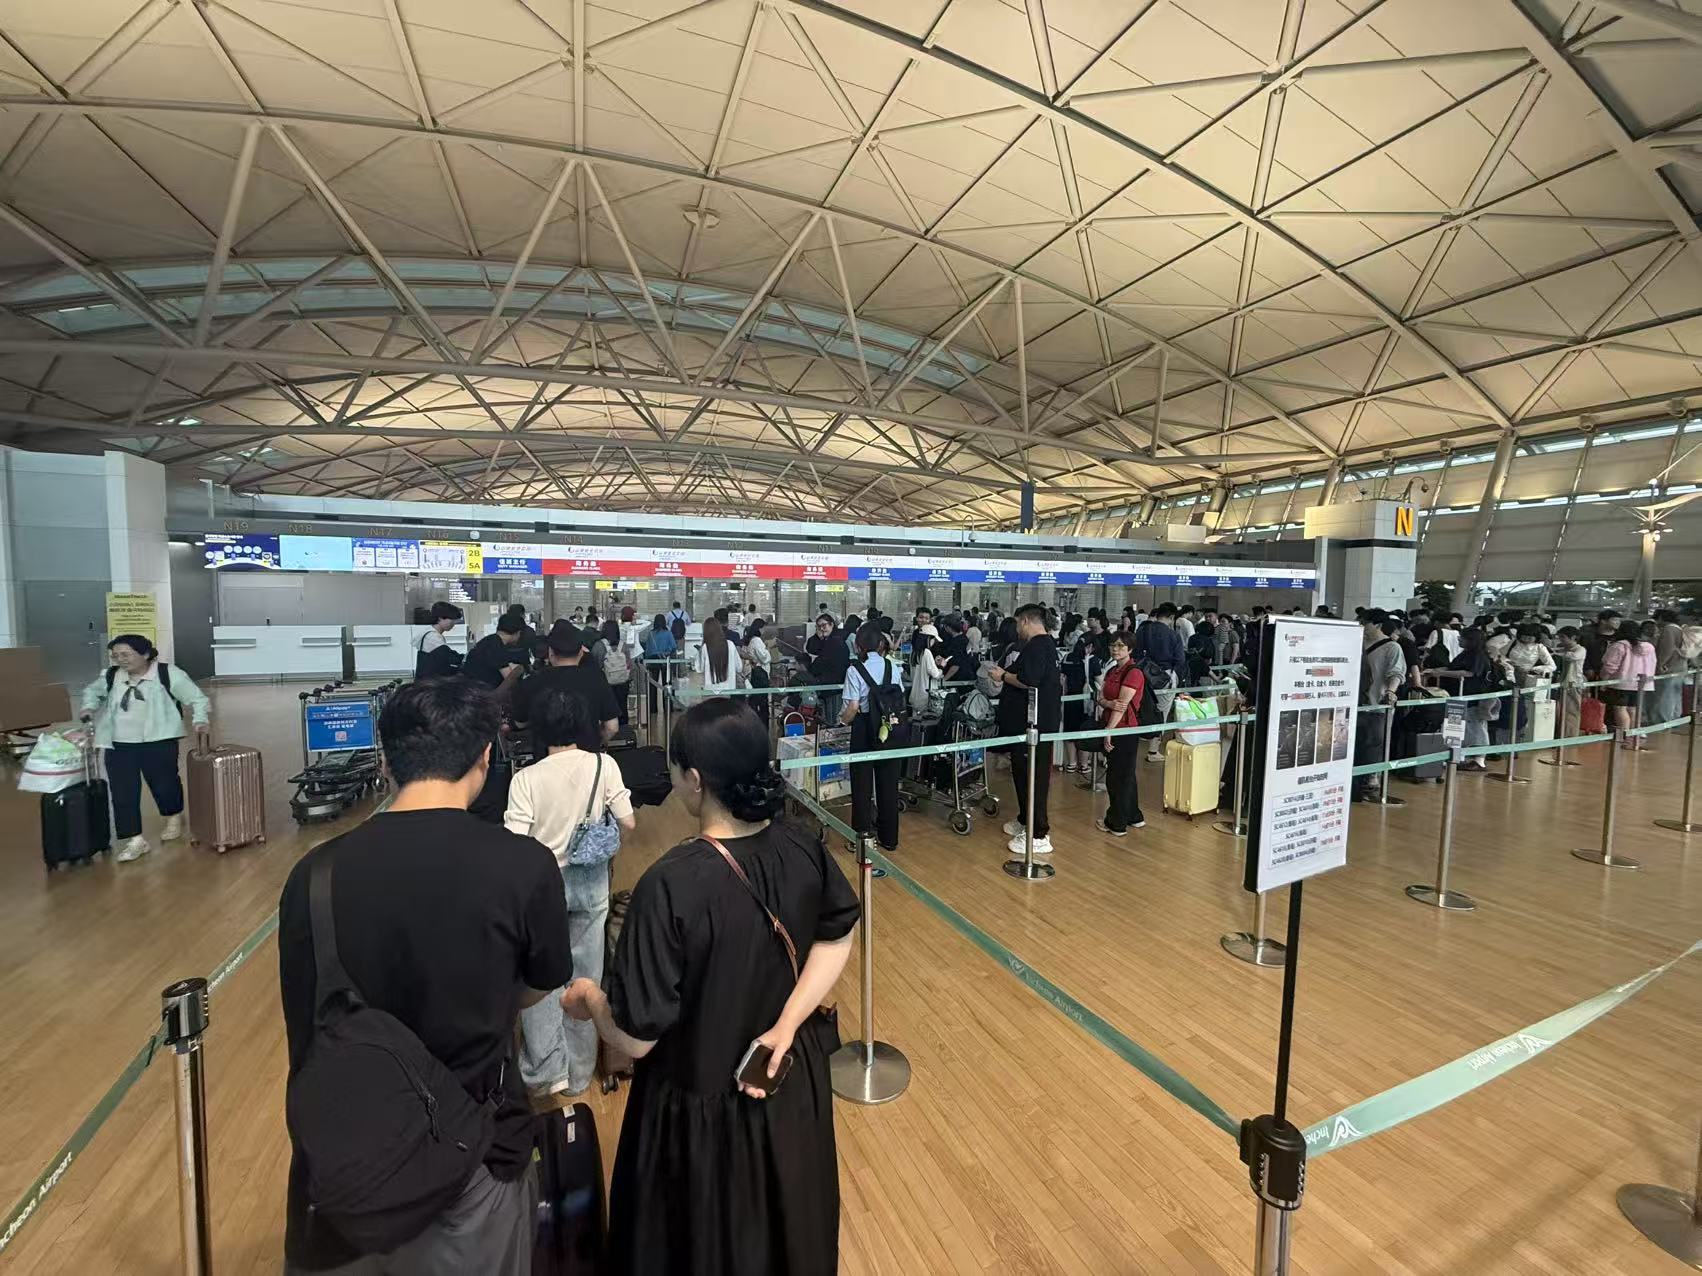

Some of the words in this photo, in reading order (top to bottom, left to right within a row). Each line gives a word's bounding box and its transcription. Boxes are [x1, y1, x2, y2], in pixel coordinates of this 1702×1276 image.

[224, 520, 248, 532] N19
[288, 523, 312, 533] N18
[1395, 506, 1413, 536] N
[1305, 1125, 1329, 1145] Inche
